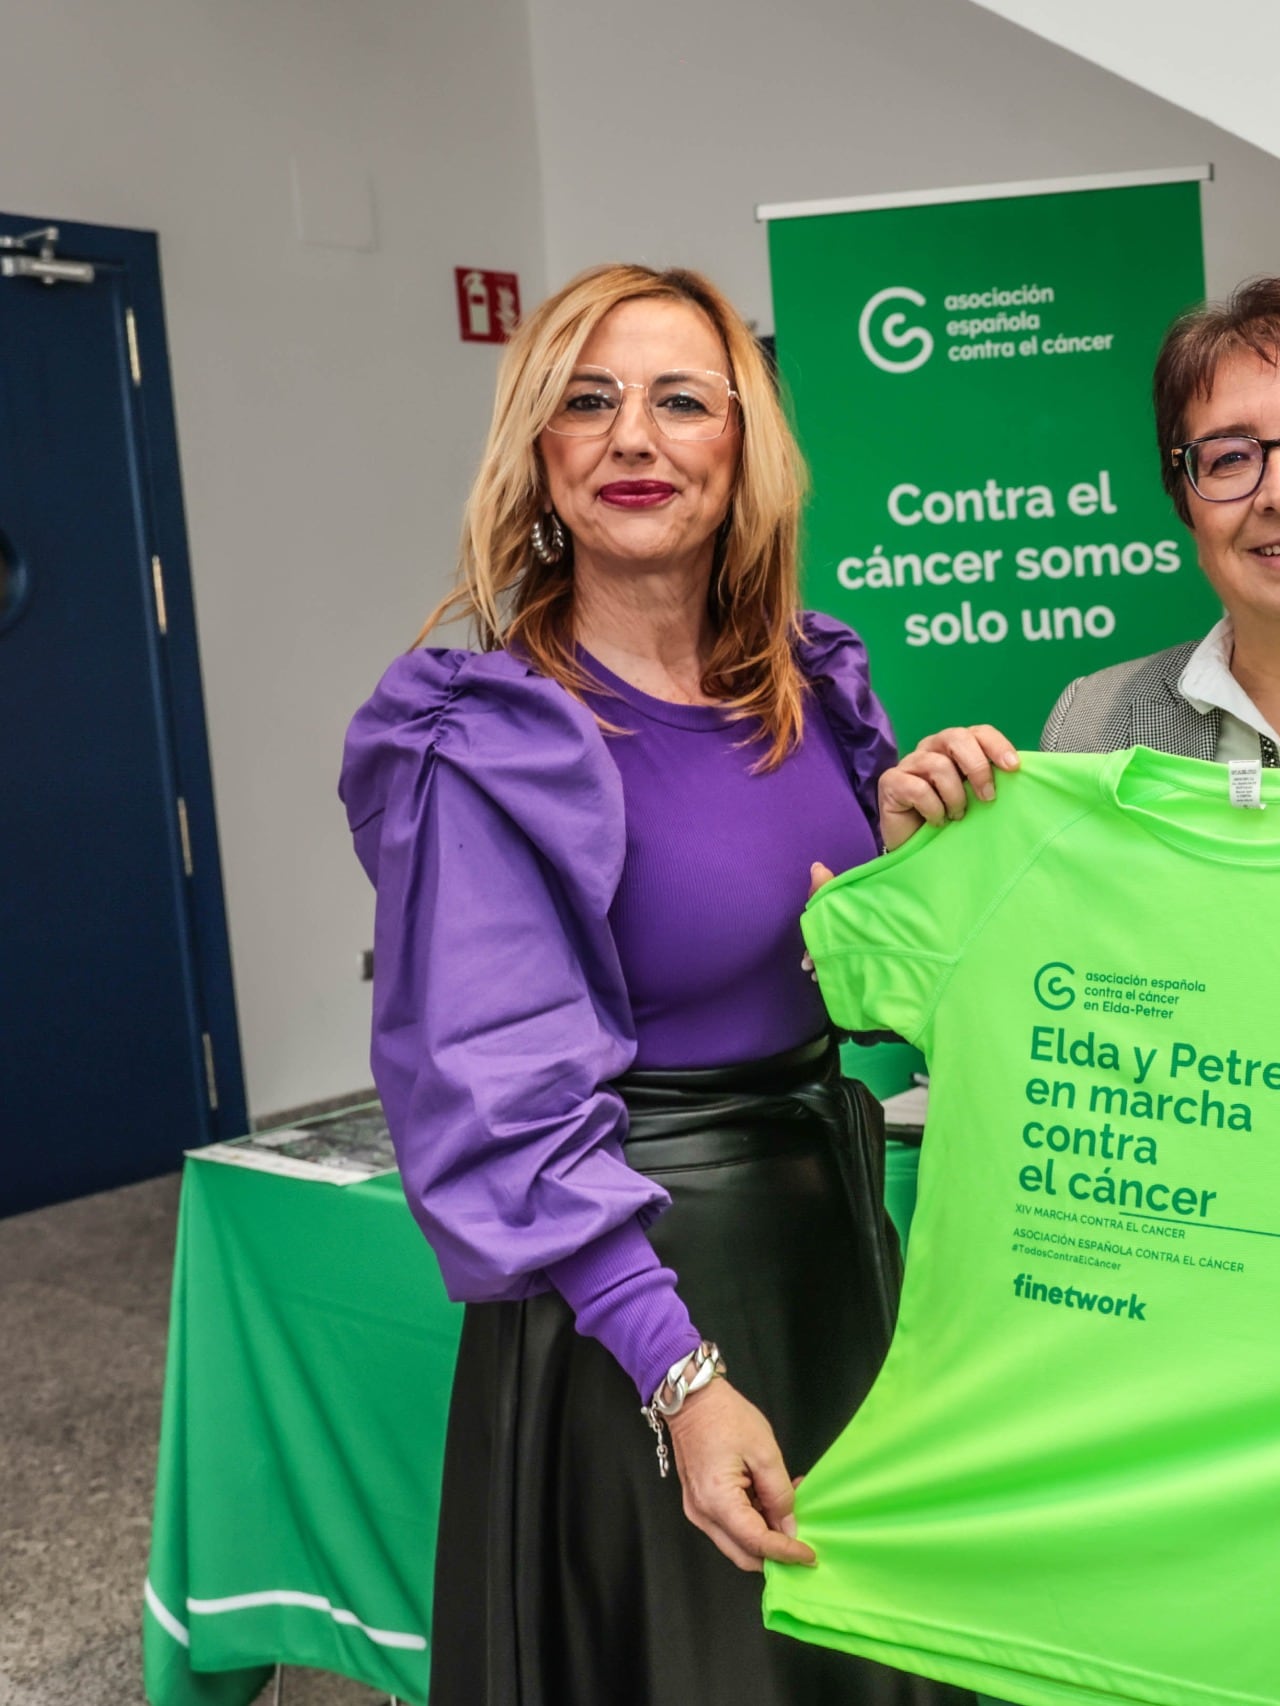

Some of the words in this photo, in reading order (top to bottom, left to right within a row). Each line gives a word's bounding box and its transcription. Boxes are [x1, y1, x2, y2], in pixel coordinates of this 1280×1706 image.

[944, 284, 1055, 311] asociación
[946, 310, 1040, 339] española
[948, 340, 1015, 361] contra
[1019, 336, 1038, 356] el
[1042, 333, 1114, 353] cáncer
[887, 479, 1055, 525] Contra
[1067, 470, 1117, 516] el
[837, 545, 1002, 589] cáncer
[1015, 540, 1181, 581] somos
[904, 601, 1008, 646] solo
[1021, 605, 1115, 641] uno
[1084, 986, 1122, 999] contra
[1126, 989, 1136, 1000] el
[1138, 991, 1180, 1005] cáncer
[1085, 972, 1148, 987] asociación
[1151, 978, 1206, 992] española
[1084, 1001, 1099, 1011] en
[1102, 1002, 1174, 1019] Elda-Petrer
[1030, 1026, 1120, 1070] Elda
[1134, 1046, 1158, 1084] y
[1026, 1076, 1076, 1109] en
[1090, 1085, 1252, 1132] marcha
[1022, 1122, 1158, 1165] contra
[1019, 1158, 1056, 1195] el
[1068, 1166, 1217, 1217] cáncer
[1015, 1204, 1032, 1214] XIV
[1034, 1207, 1078, 1222] MARCHA
[1080, 1215, 1124, 1230] CONTRA
[1126, 1222, 1139, 1232] EL
[1141, 1224, 1186, 1238] CANCER
[1013, 1228, 1076, 1246] ASOCIACIÓN
[1078, 1239, 1133, 1256] ESPAÑOLA
[1136, 1248, 1180, 1264] CONTRA
[1183, 1255, 1196, 1266] EL
[1199, 1257, 1245, 1272] CÁNCER
[1013, 1273, 1147, 1320] finetwork
